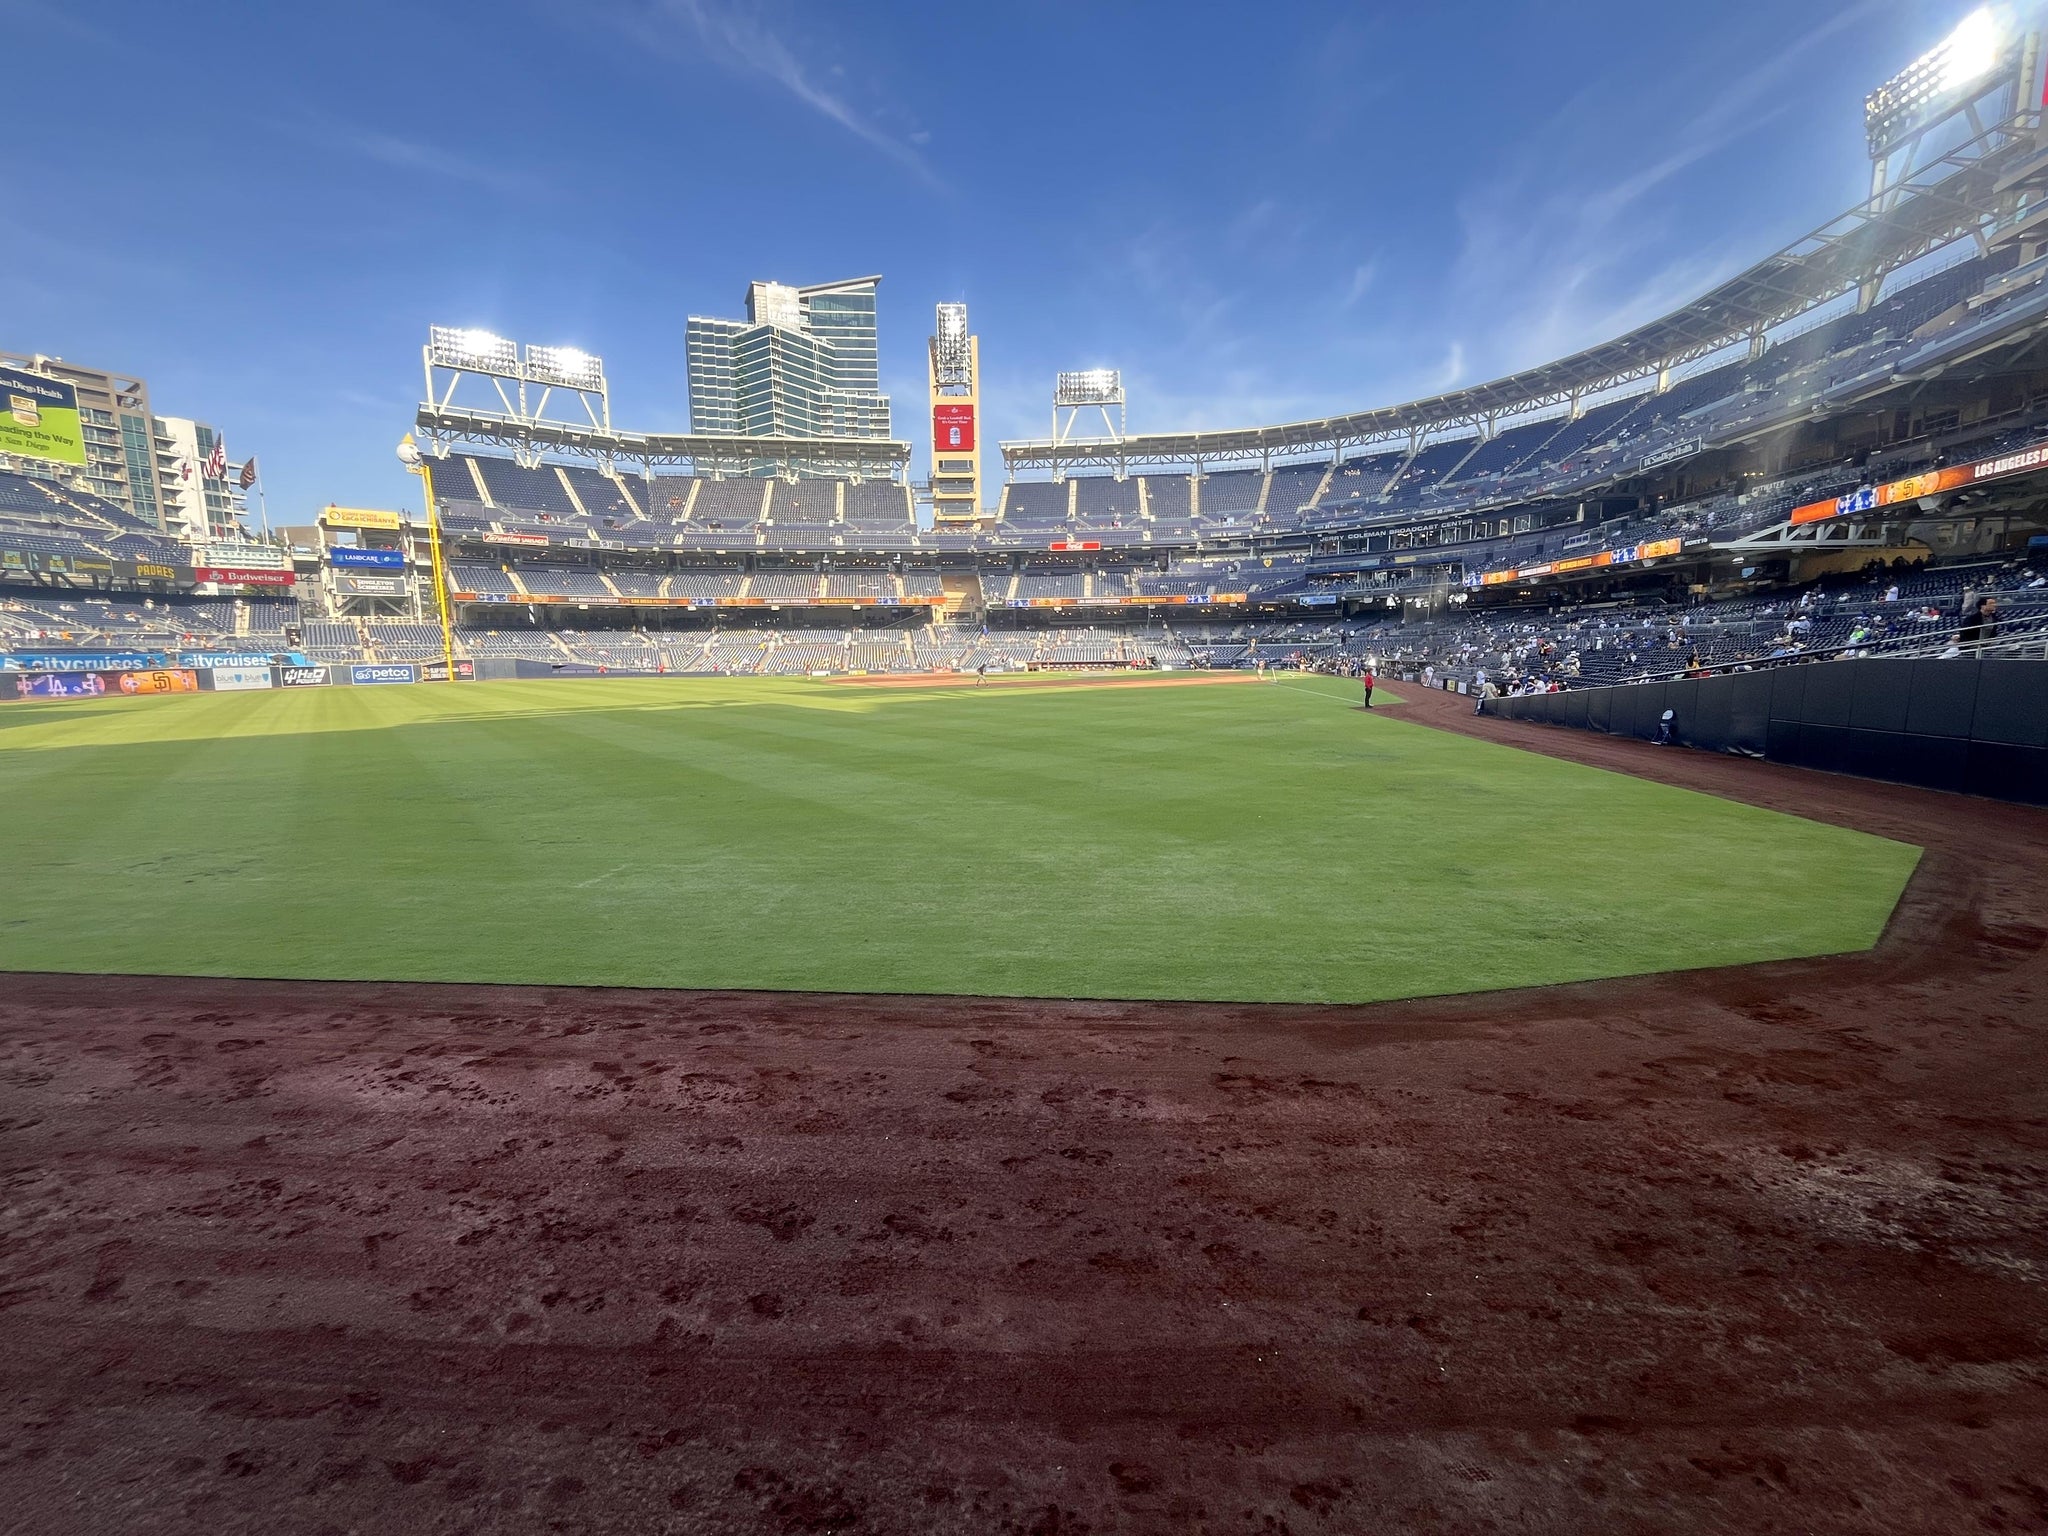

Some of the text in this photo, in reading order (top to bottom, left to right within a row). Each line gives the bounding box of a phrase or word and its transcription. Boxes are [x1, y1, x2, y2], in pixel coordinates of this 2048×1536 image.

[12, 380, 36, 393] Diego
[36, 386, 63, 400] Health
[0, 425, 74, 447] eading the Way
[1975, 461, 1994, 478] LOS
[1994, 450, 2041, 473] ANGELES
[1320, 518, 1473, 542] JERRY COLEMAN BROADCAST CENTER
[345, 554, 379, 562] LANDCARE
[136, 564, 175, 579] PADRES
[228, 572, 285, 582] Budweiser
[186, 655, 268, 668] citycruises
[372, 667, 409, 680] petco
